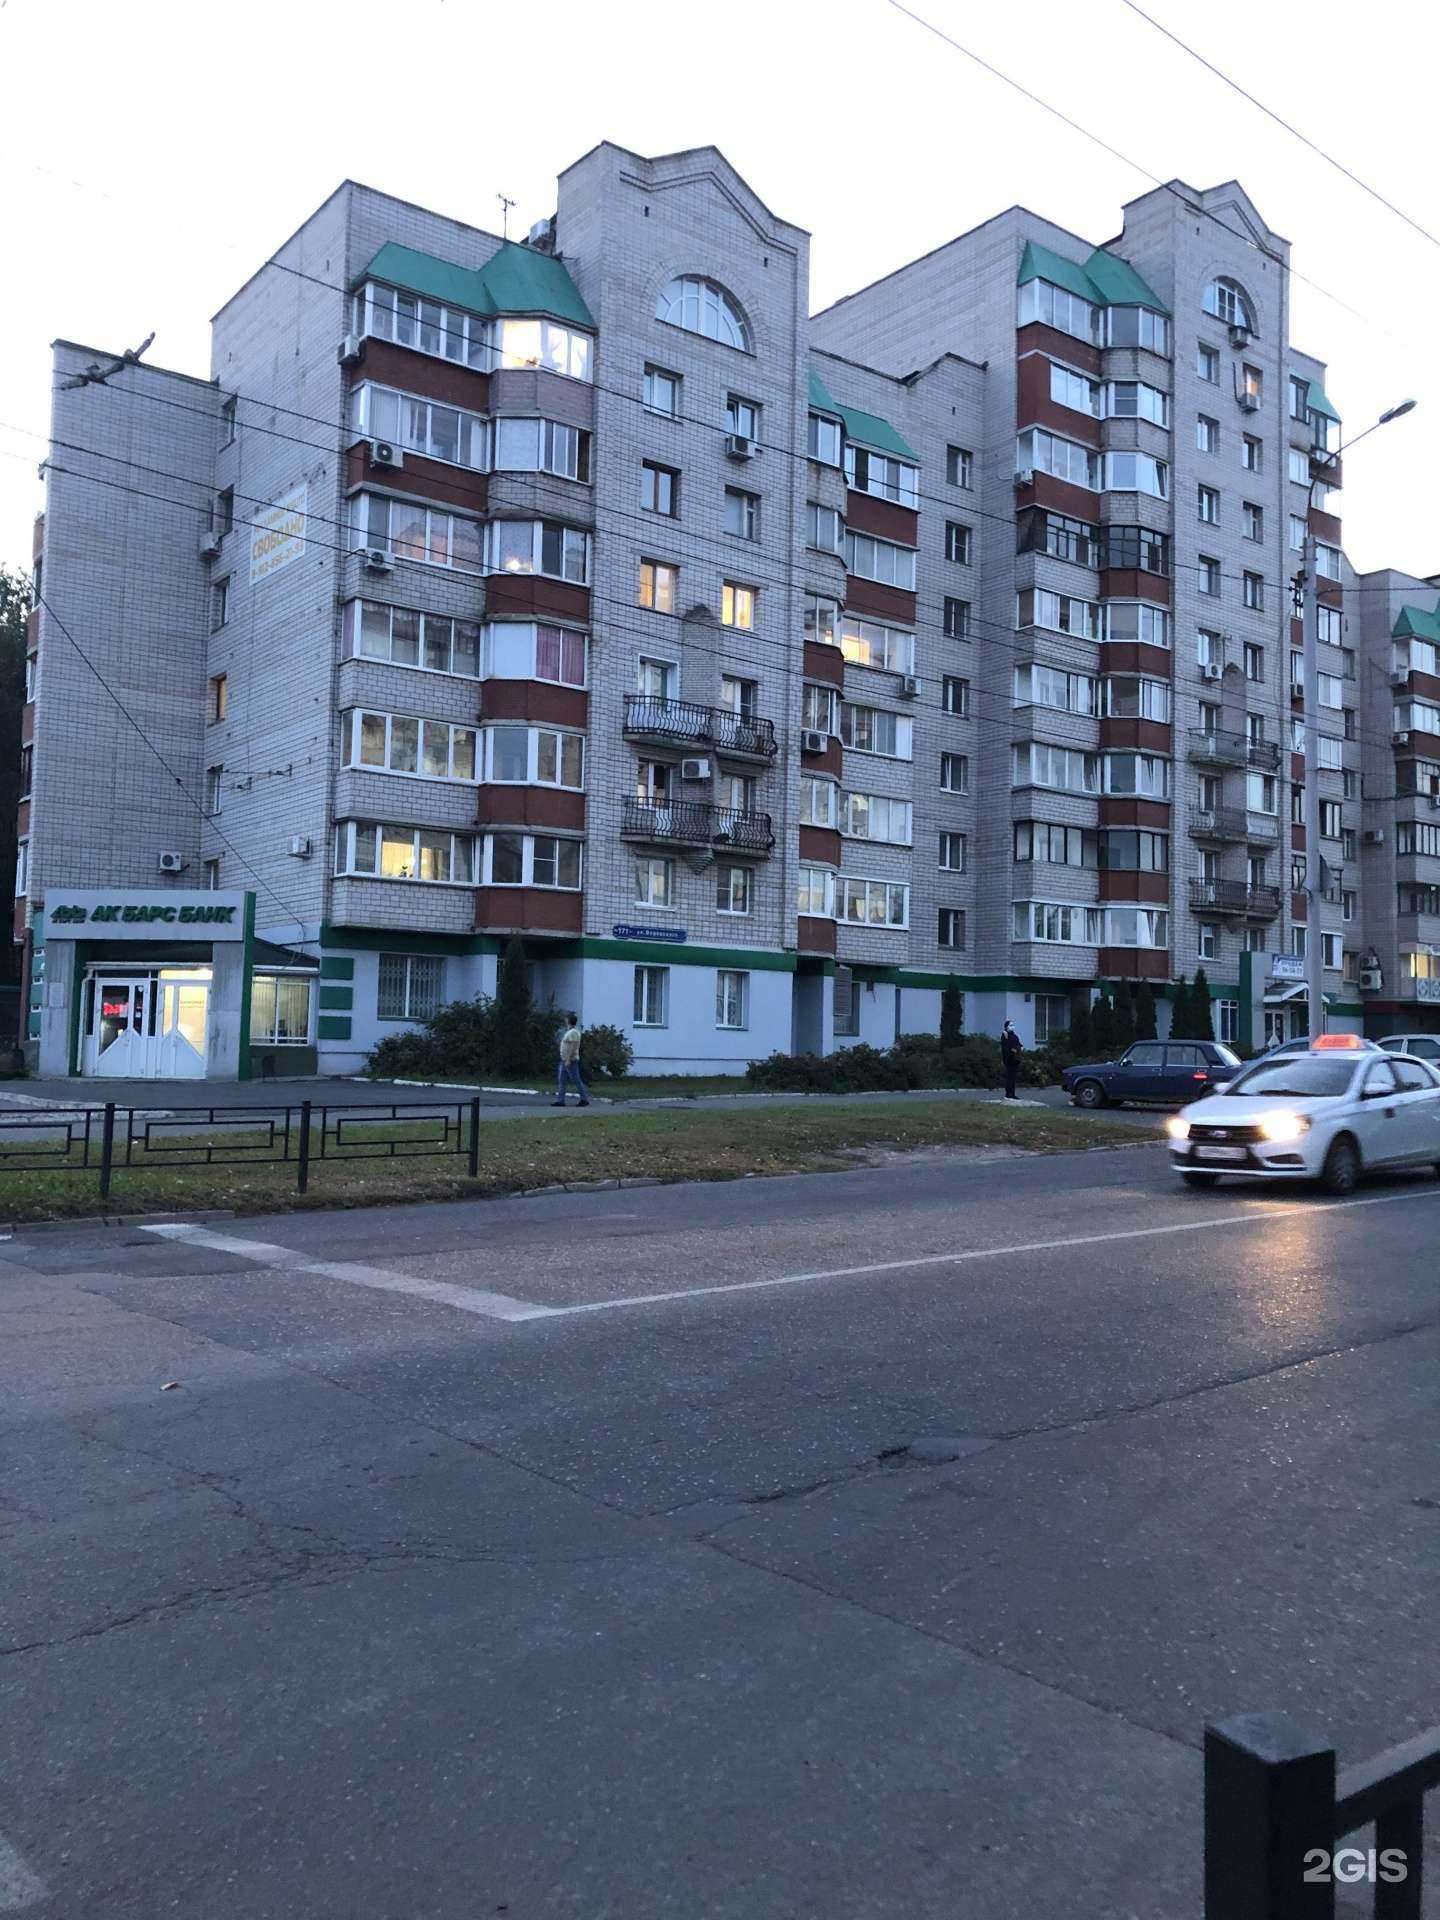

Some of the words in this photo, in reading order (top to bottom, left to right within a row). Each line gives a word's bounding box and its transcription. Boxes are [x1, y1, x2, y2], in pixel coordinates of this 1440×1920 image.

[90, 905, 122, 922] АК
[122, 905, 177, 923] БАРС
[178, 906, 237, 923] БАНК
